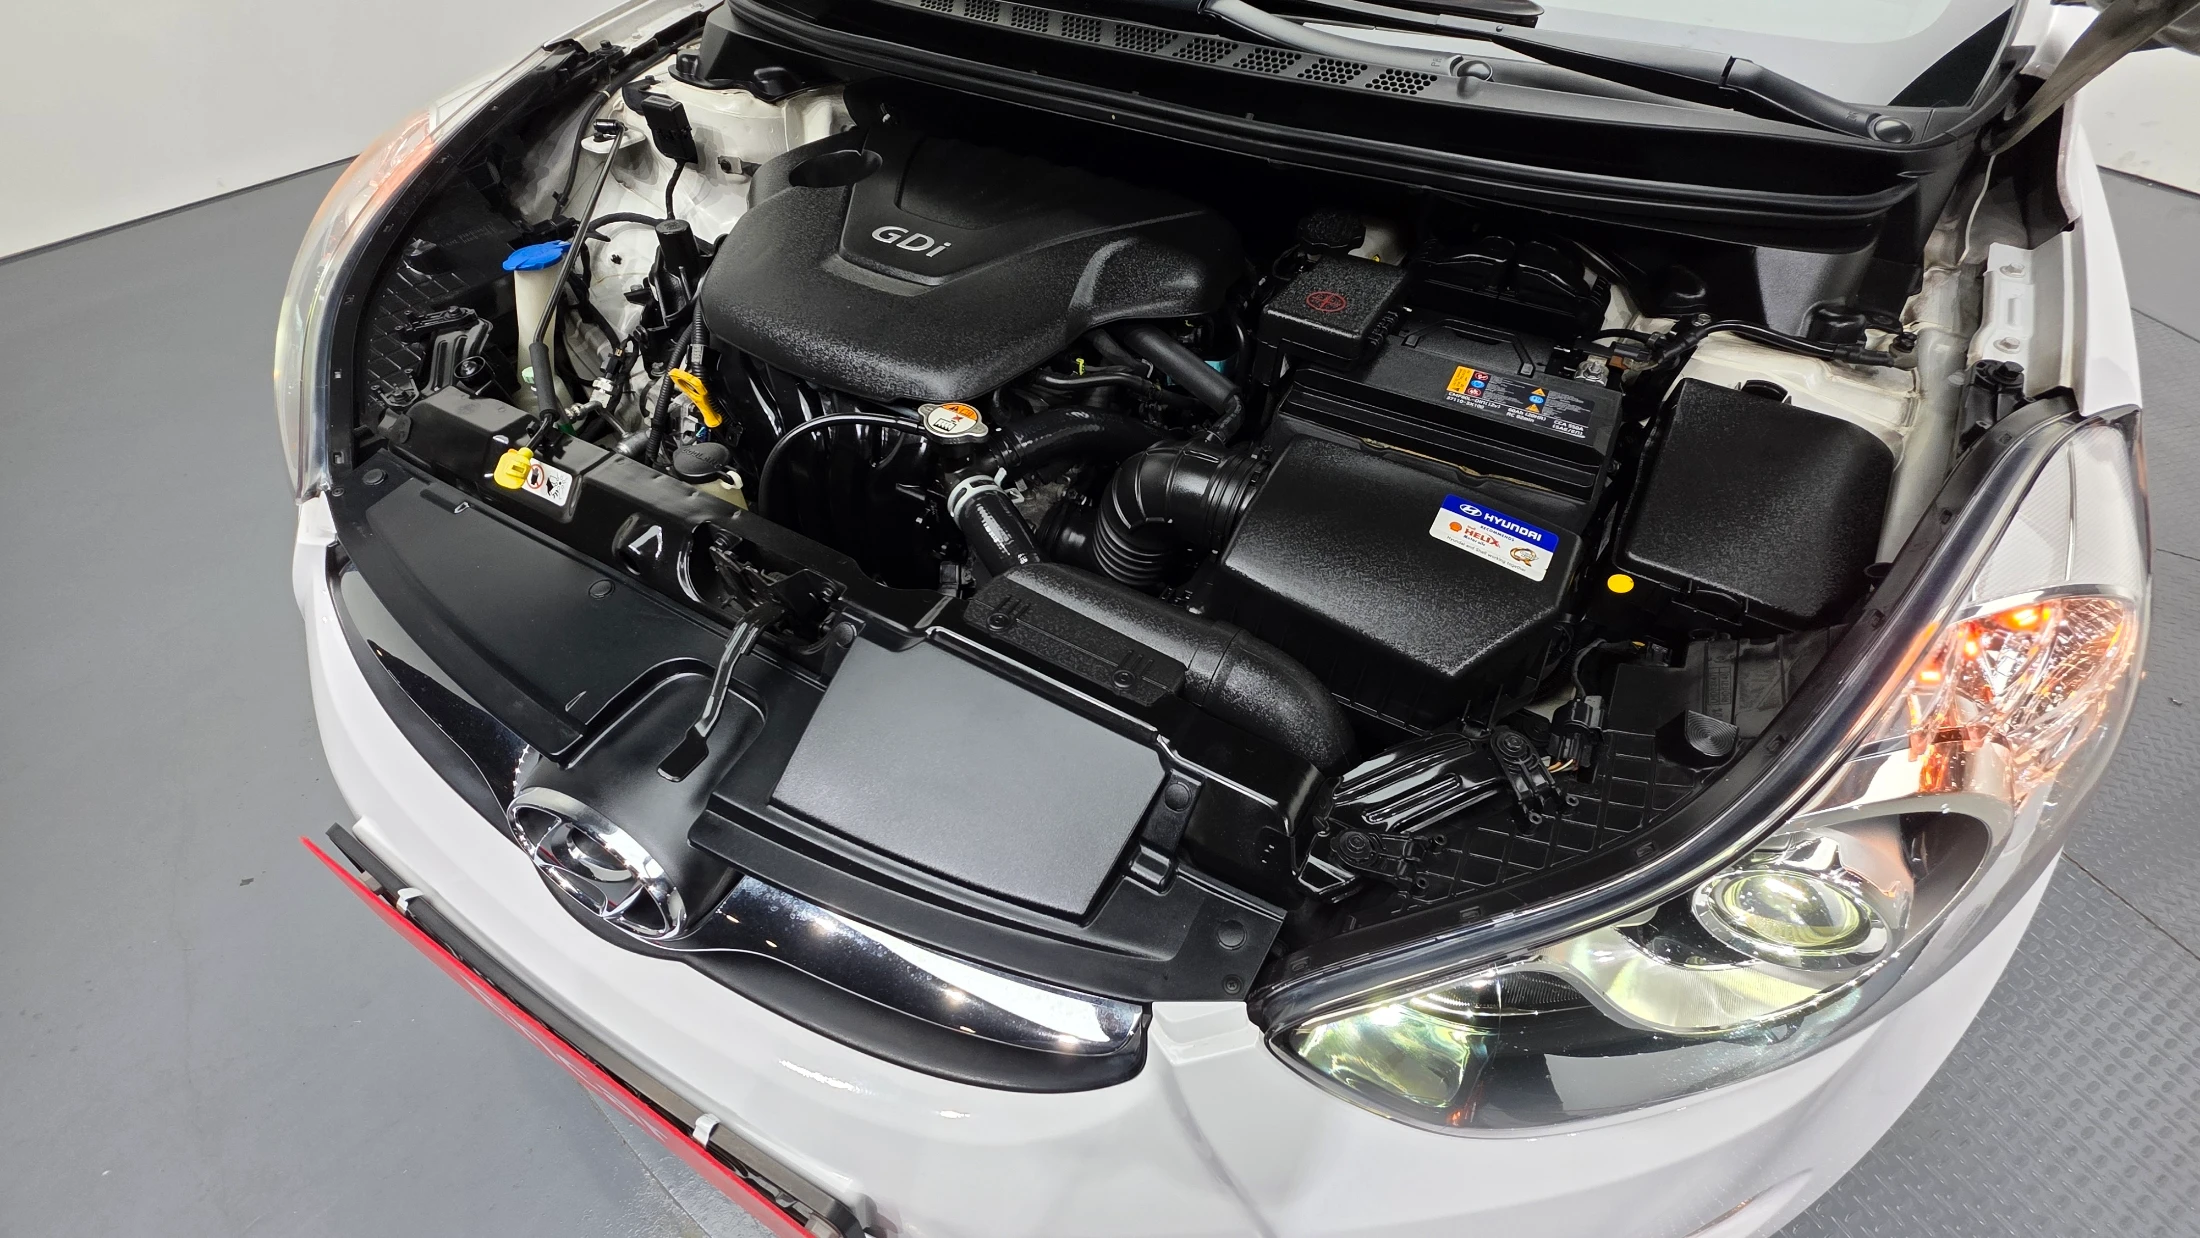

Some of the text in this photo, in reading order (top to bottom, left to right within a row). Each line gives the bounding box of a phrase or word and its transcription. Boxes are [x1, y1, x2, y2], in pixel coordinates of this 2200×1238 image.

[871, 225, 952, 258] GDi
[1464, 528, 1500, 548] HELIX
[1480, 525, 1515, 542] RECOMMENDS
[1483, 512, 1542, 542] HYUNDAI
